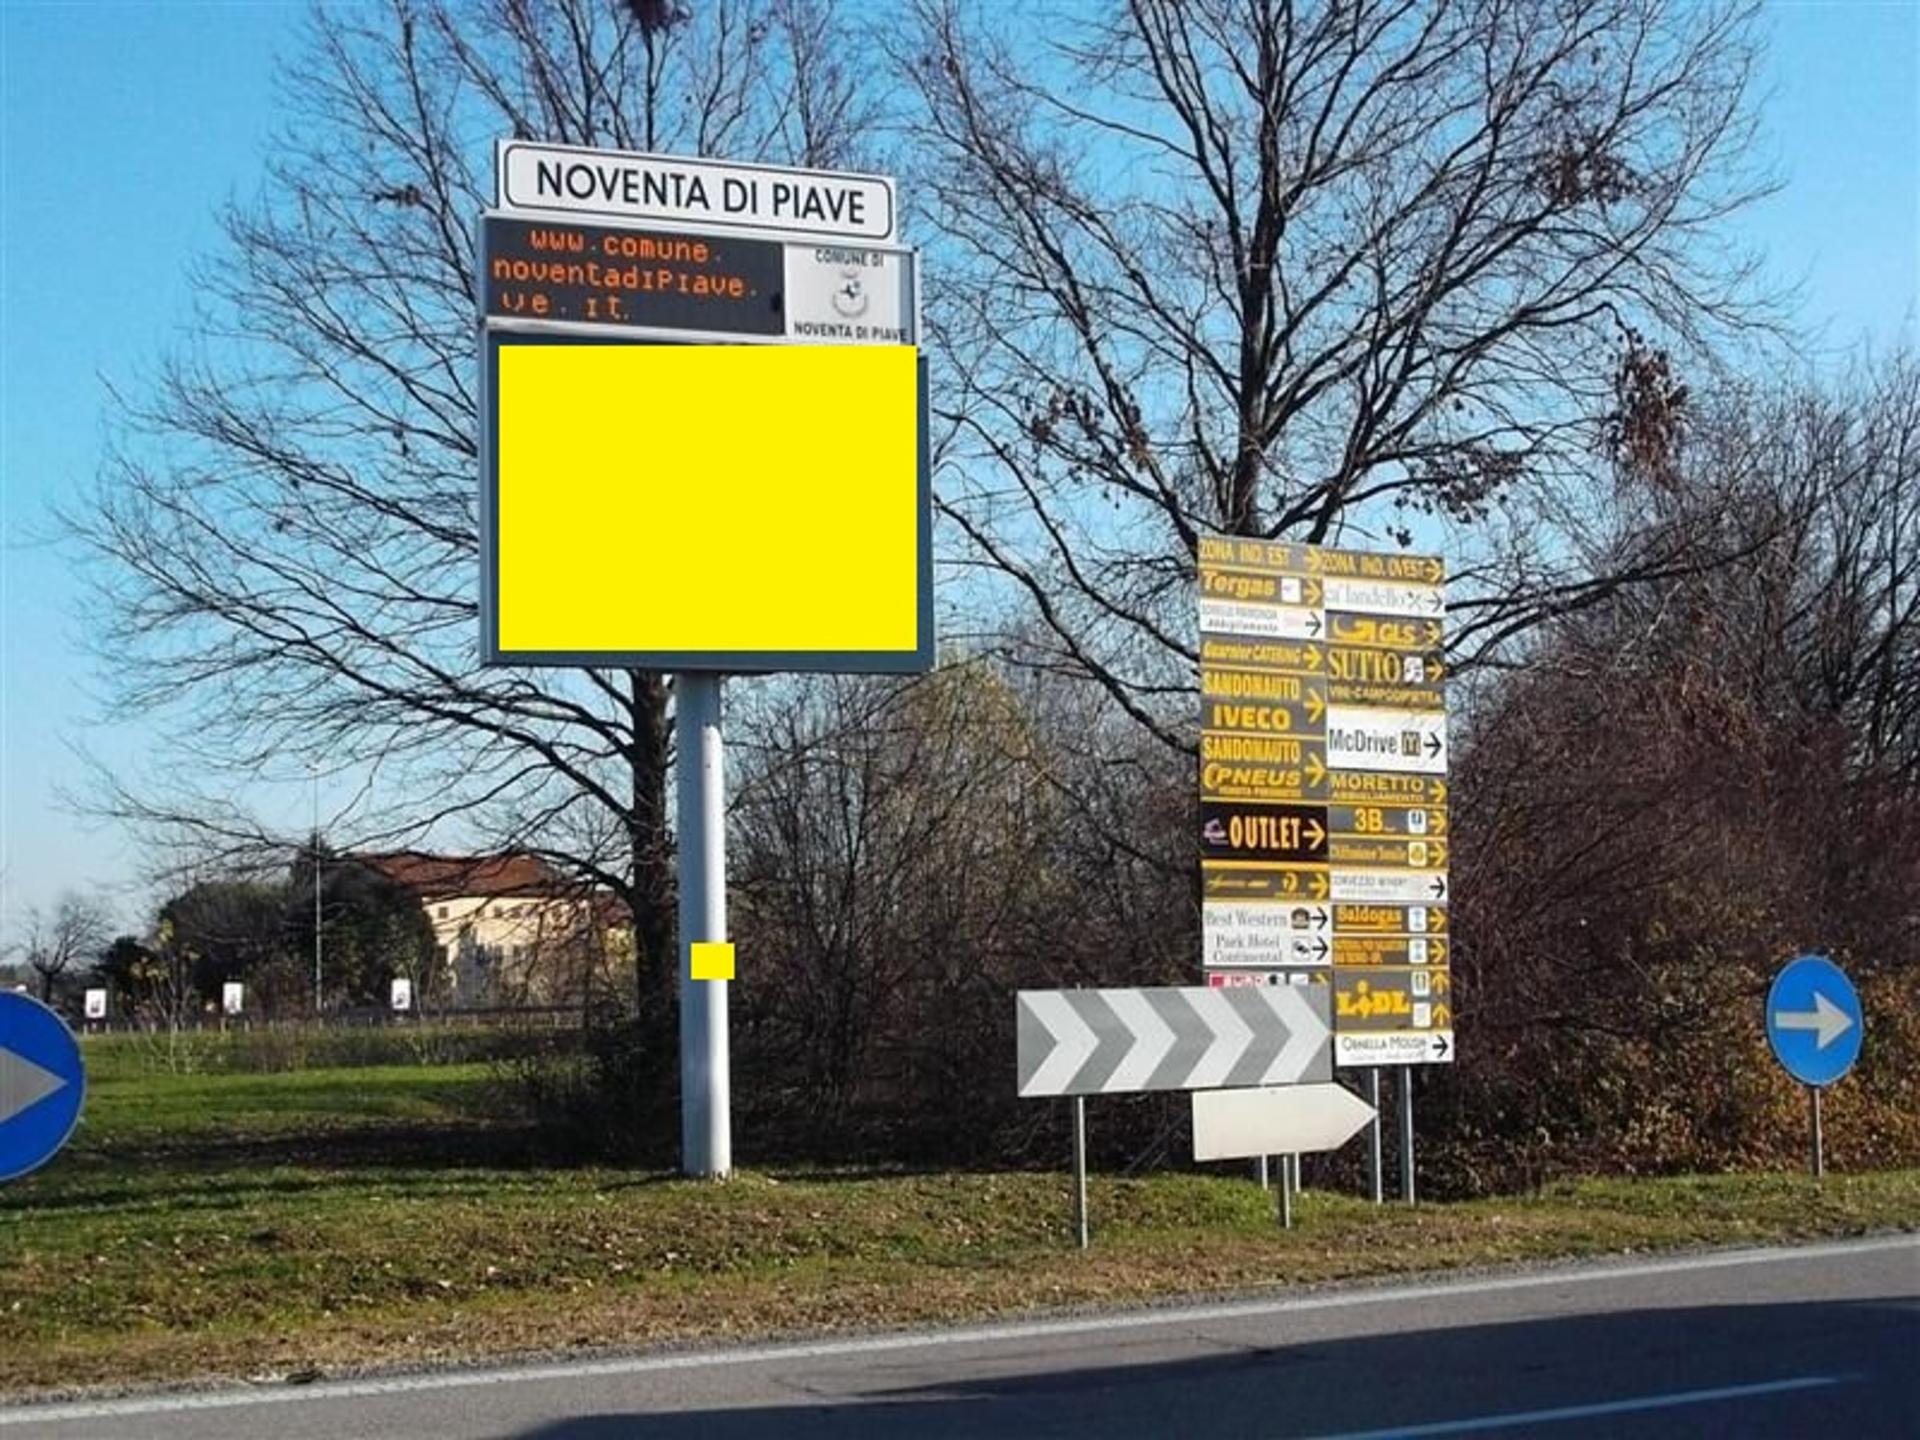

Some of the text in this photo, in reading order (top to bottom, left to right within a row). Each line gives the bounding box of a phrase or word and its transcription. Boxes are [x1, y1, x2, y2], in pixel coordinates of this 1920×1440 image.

[536, 160, 866, 225] NOVENTA DI PIAVE
[815, 248, 885, 268] COMUNE DI
[794, 321, 907, 342] NOVENTA DI PIAVE
[1200, 539, 1234, 562] ZONA
[1322, 550, 1357, 576] ZONA
[1388, 557, 1424, 580] OVEST
[1379, 622, 1417, 645] GLS
[1327, 650, 1401, 684] SUTTO
[1203, 671, 1301, 702] SANDONAUTO
[1213, 704, 1291, 731] IVECO
[1203, 736, 1301, 765] SANDONAUTO
[1328, 729, 1397, 754] McDrive
[1330, 775, 1424, 793] MORETTO
[1229, 815, 1300, 850] OUTLET
[1355, 808, 1383, 833] 3B
[1235, 909, 1288, 928] Western
